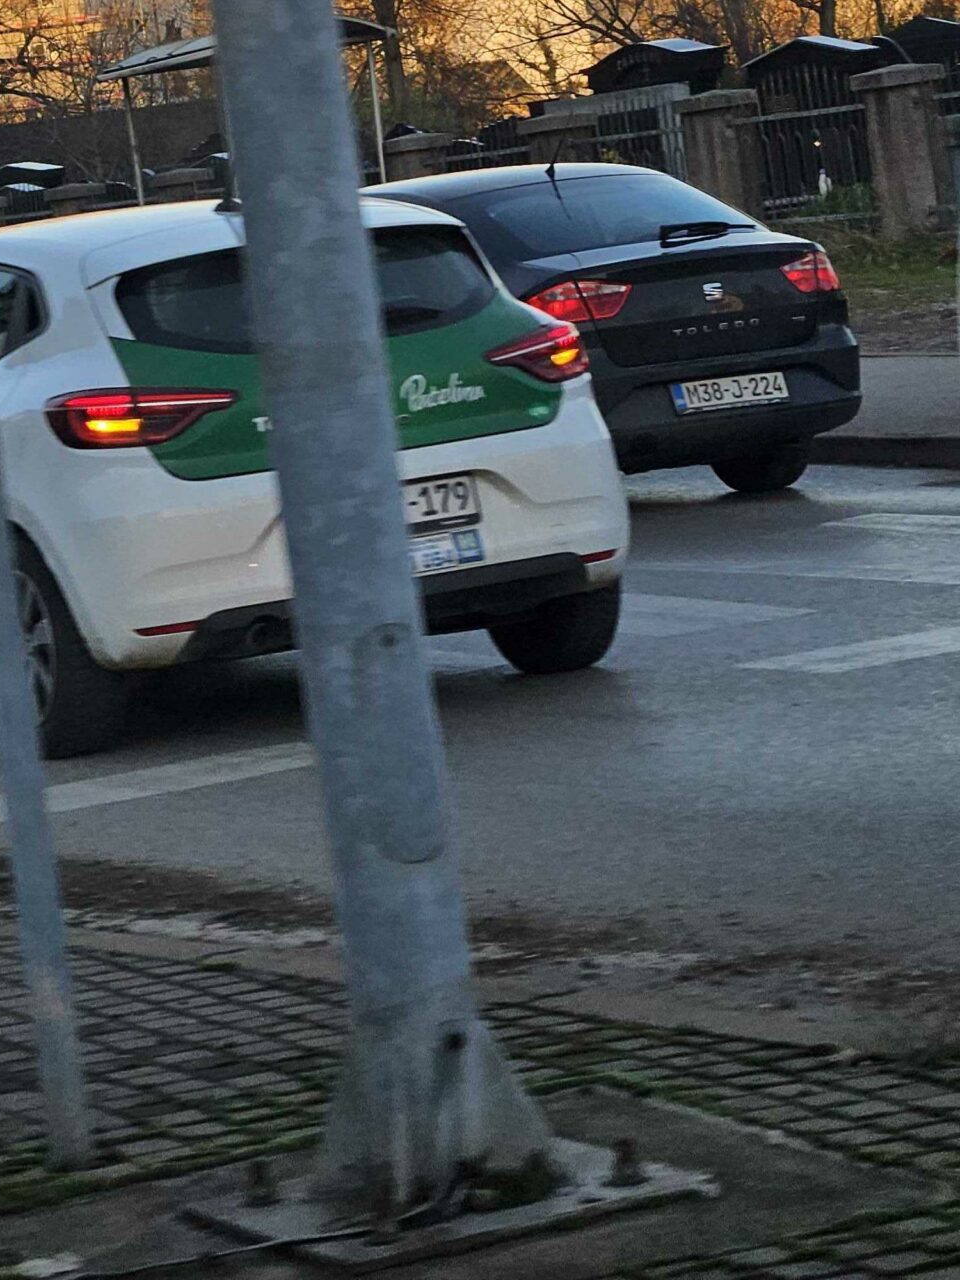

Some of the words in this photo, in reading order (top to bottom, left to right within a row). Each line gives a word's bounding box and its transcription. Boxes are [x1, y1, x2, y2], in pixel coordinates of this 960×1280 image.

[672, 318, 760, 336] TOLEDO
[685, 375, 784, 405] M38-J-224
[407, 481, 471, 516] -179
